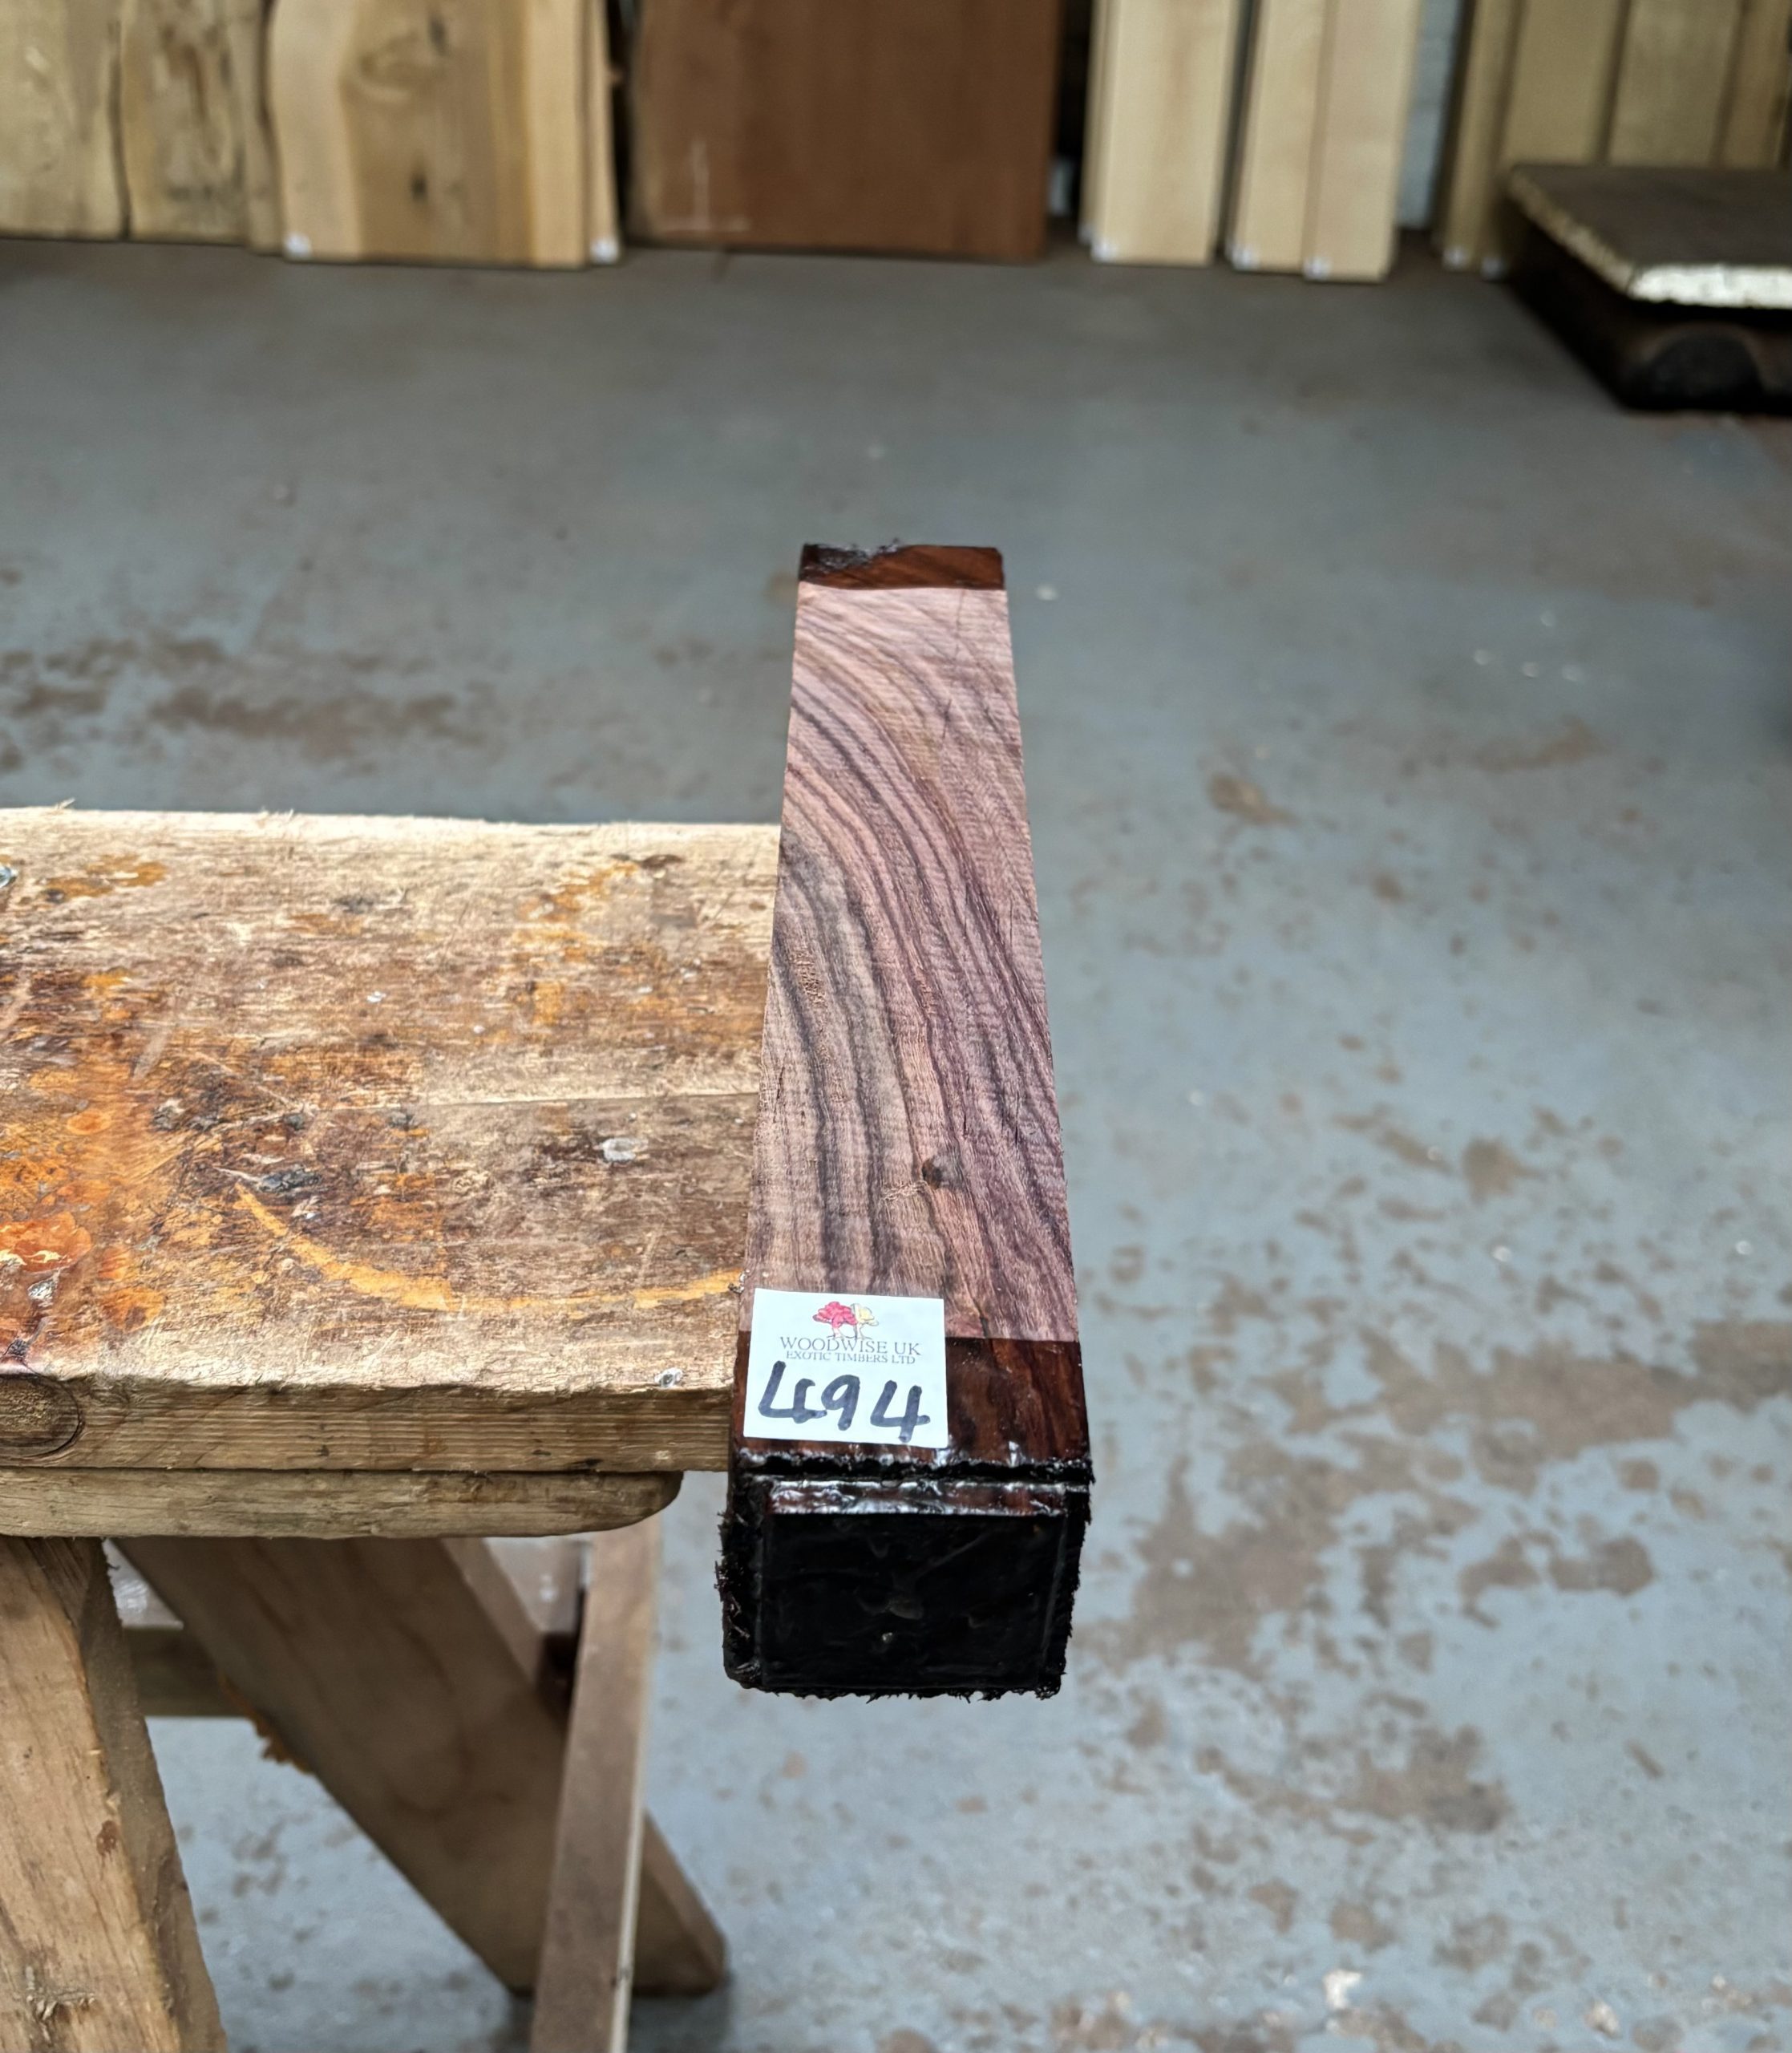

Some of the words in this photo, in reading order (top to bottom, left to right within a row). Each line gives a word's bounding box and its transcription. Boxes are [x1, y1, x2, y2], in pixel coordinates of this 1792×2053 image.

[780, 1337, 888, 1354] WOODWISE
[894, 1342, 921, 1355] UK
[786, 1350, 831, 1361] EXOTIC
[836, 1352, 888, 1363] TIMBERS
[892, 1355, 916, 1364] LTD
[758, 1360, 931, 1443] 494
